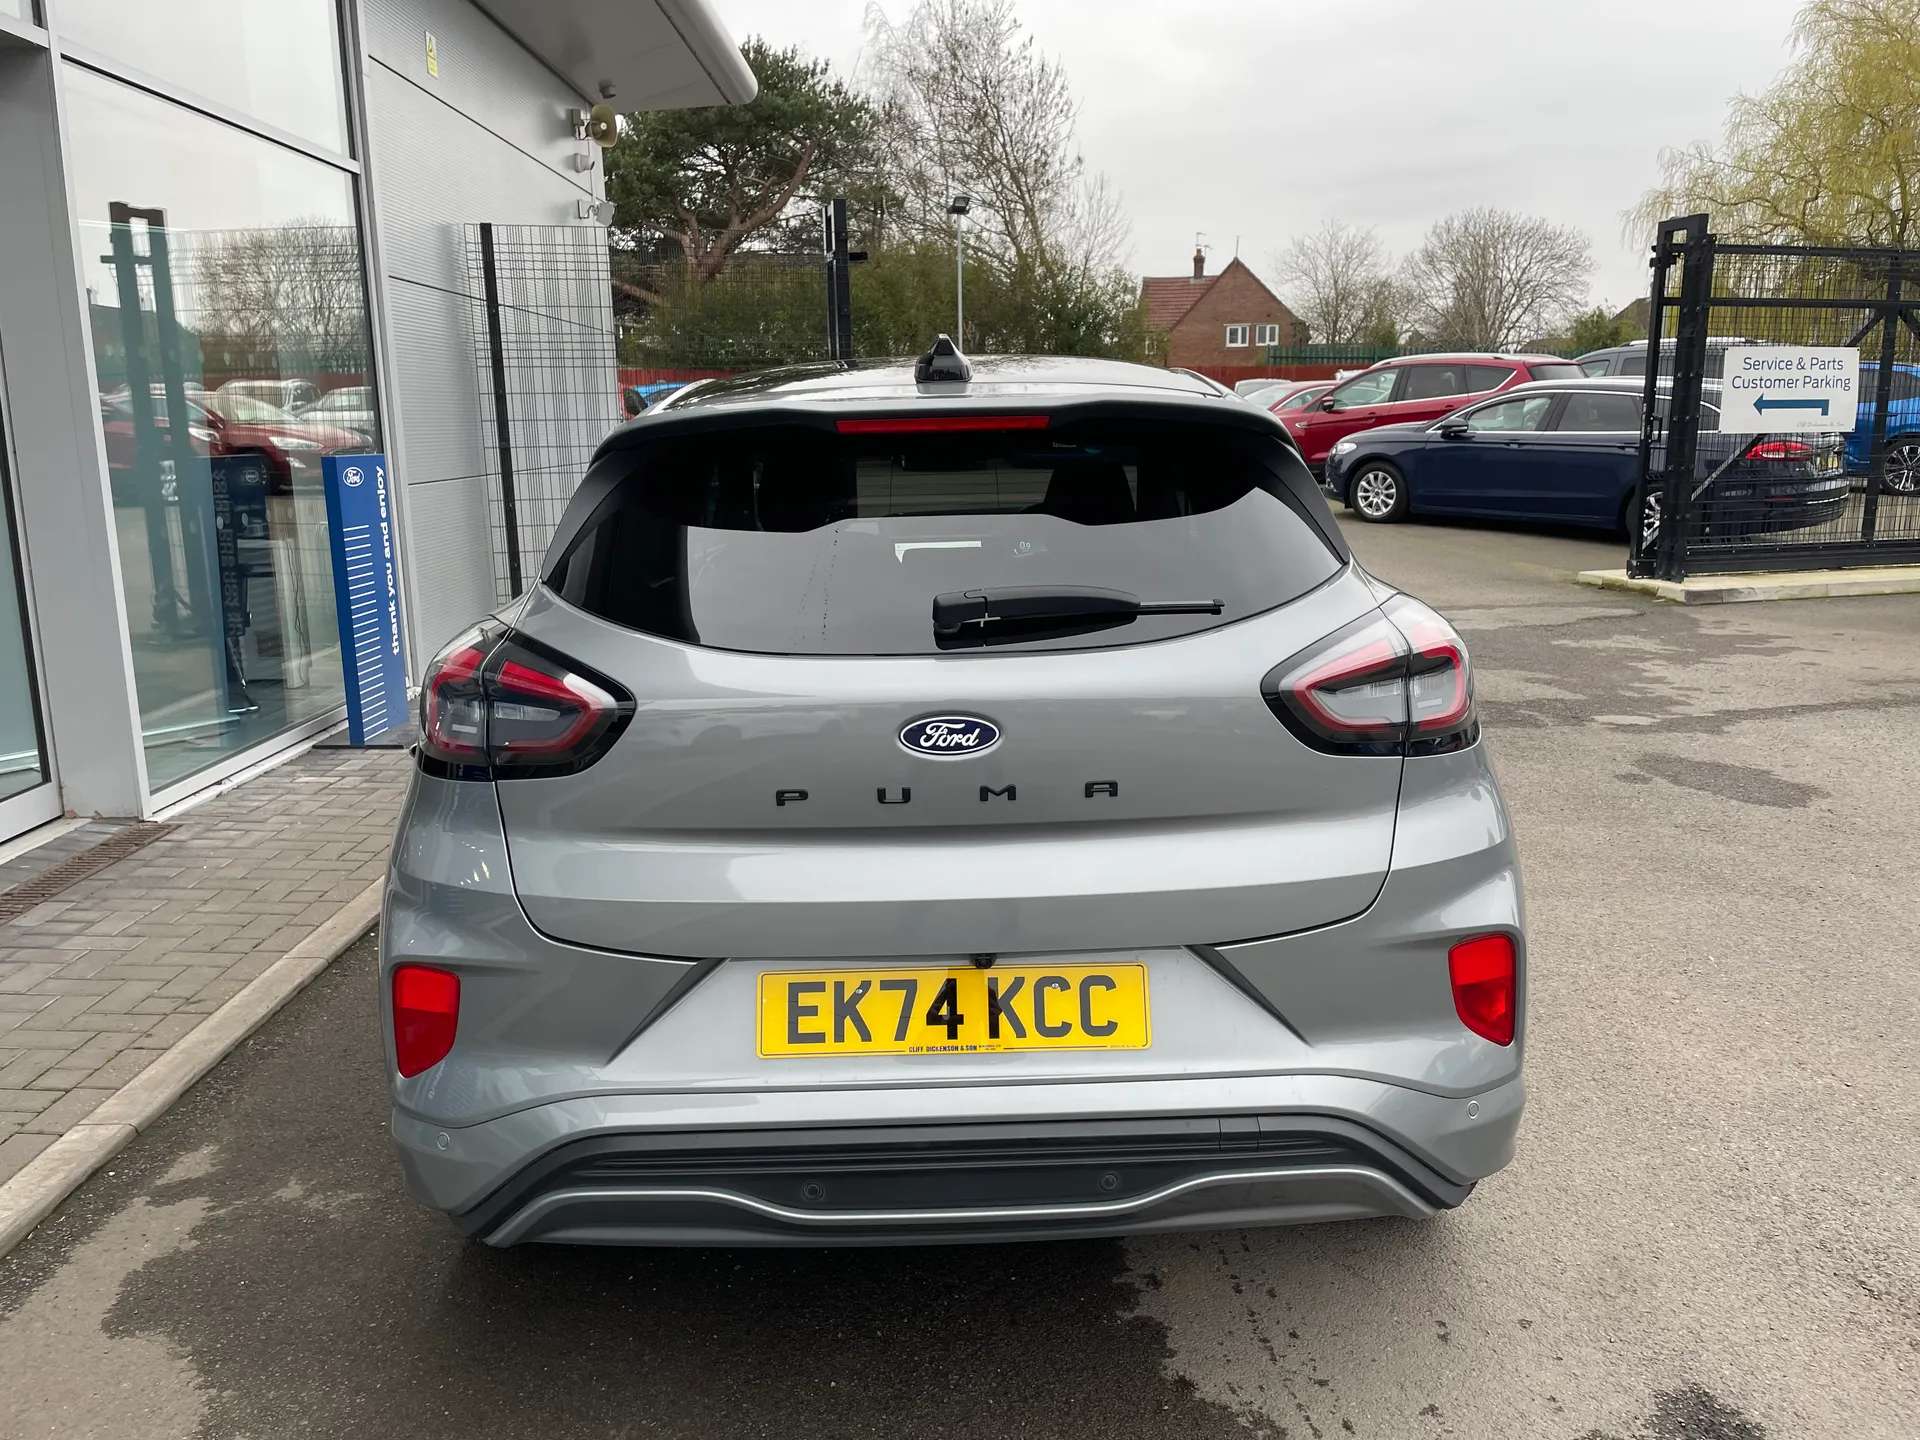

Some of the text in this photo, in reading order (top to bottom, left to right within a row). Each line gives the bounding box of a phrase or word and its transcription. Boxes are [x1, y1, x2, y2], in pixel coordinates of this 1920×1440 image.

[1743, 356, 1844, 370] Service & Parts
[1731, 374, 1851, 391] Customer Parking
[376, 465, 400, 656] thank you and enjoy
[919, 722, 981, 748] Ford
[775, 780, 1119, 807] PUMA
[787, 974, 1119, 1045] EK74 KCC
